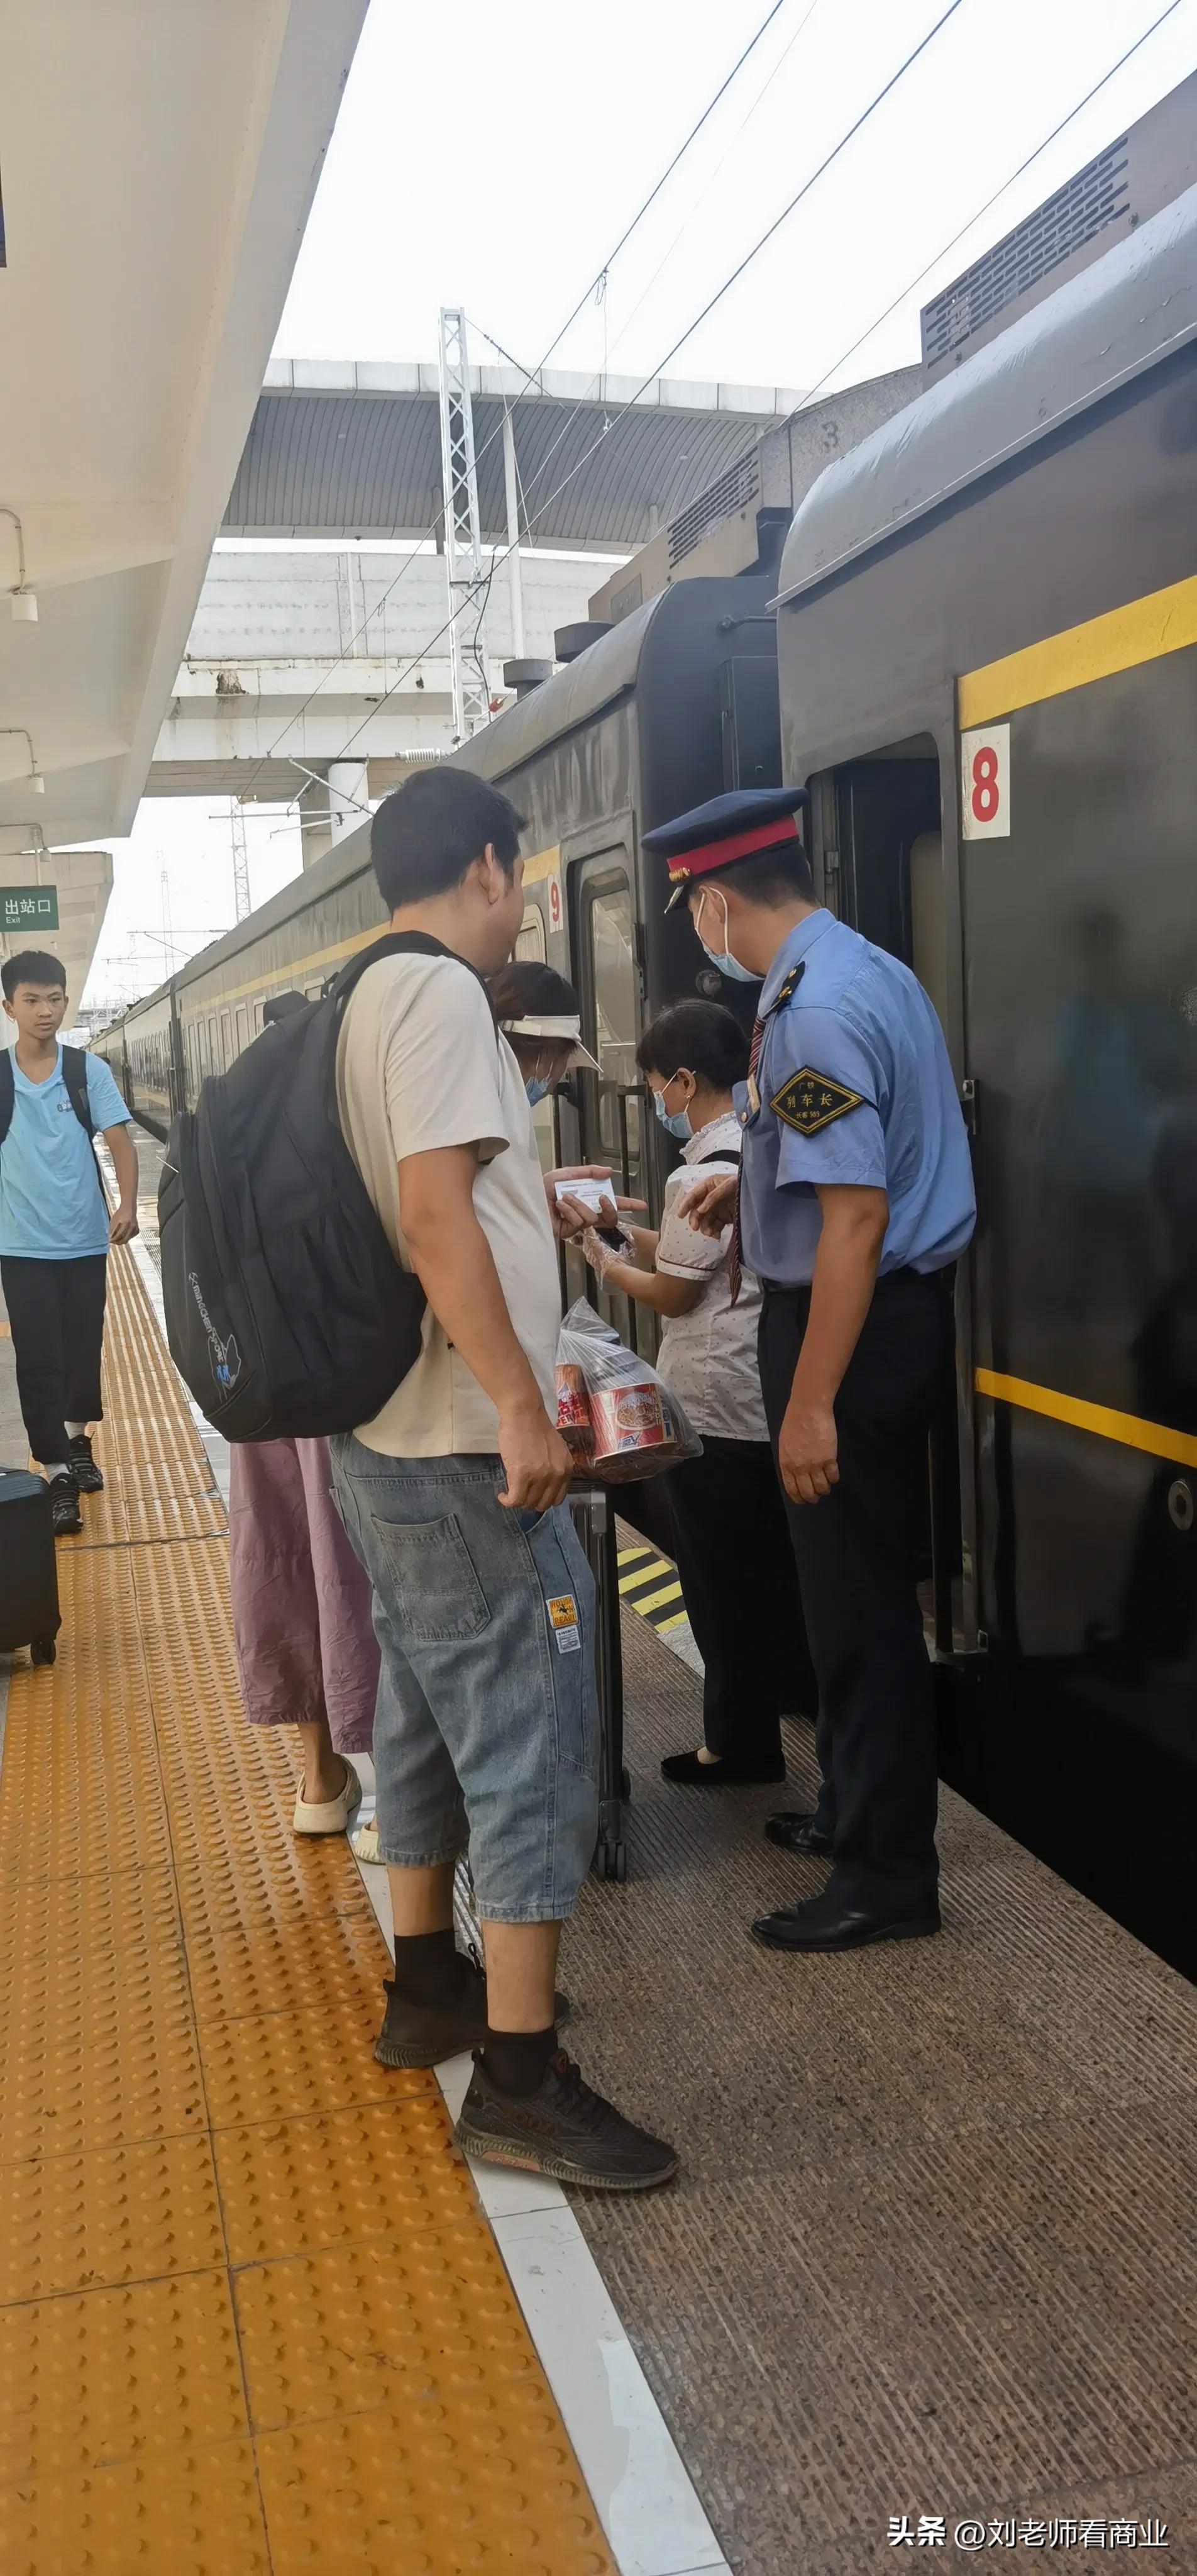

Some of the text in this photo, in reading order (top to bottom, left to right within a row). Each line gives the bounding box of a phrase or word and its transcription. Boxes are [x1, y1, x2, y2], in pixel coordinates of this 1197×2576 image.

[972, 747, 999, 823] 8
[5, 898, 51, 915] 出站口
[551, 882, 560, 922] 9
[786, 1092, 833, 1110] 列车长
